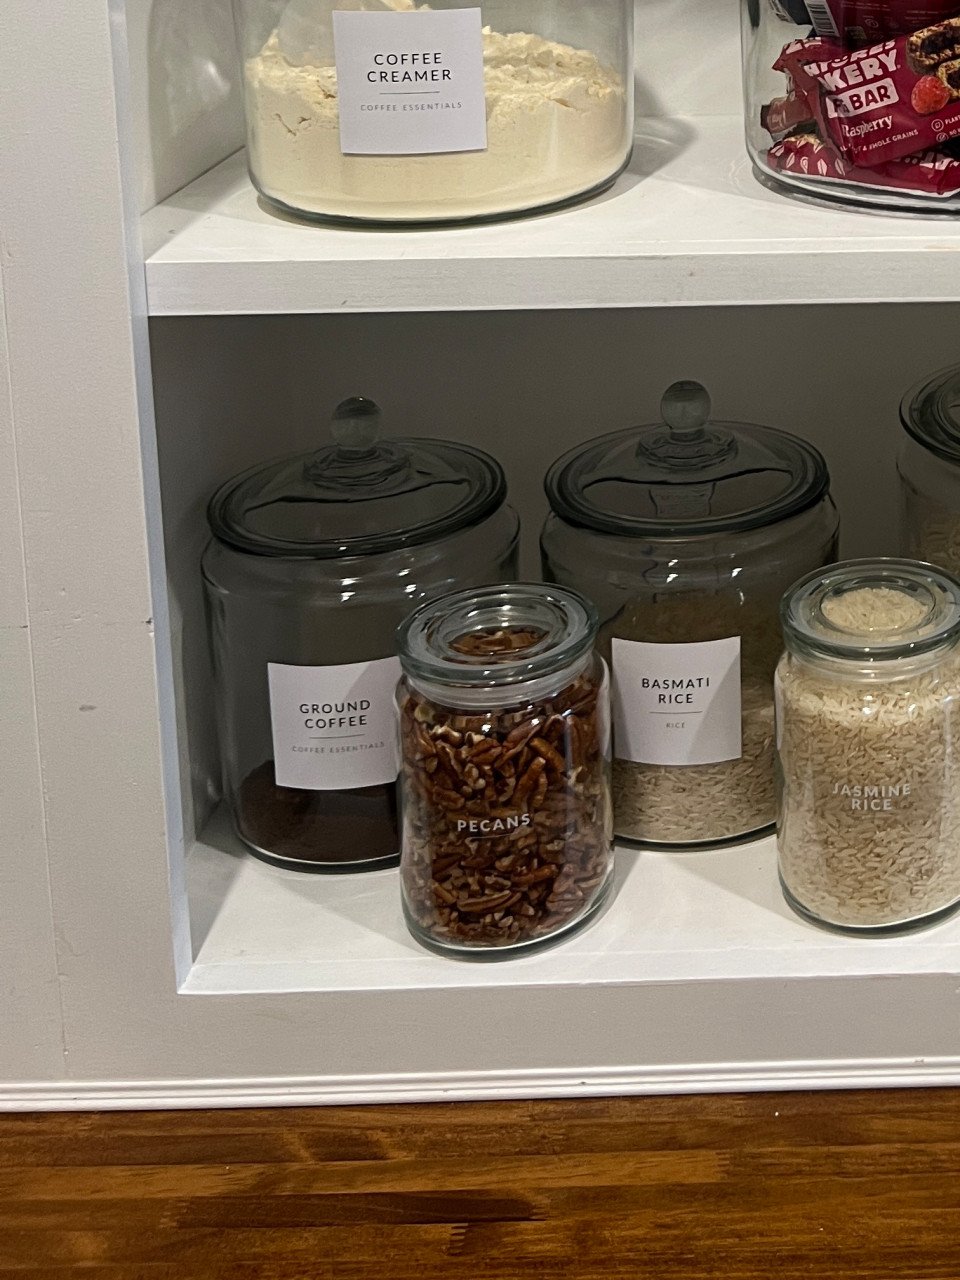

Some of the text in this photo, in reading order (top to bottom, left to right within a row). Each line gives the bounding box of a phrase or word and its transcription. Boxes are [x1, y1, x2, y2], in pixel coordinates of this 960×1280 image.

[373, 52, 443, 67] COFFEE
[366, 69, 453, 84] CREAMER
[359, 101, 463, 113] COFFEE ESSENTIALS
[841, 115, 893, 139] Raspberry
[641, 676, 711, 690] BASMATI
[658, 693, 695, 705] RICE
[299, 699, 371, 715] GROUND
[304, 714, 369, 730] COFFEE
[665, 721, 687, 729] RICE
[291, 741, 386, 754] COFFEE ESSENTIALS
[832, 782, 912, 798] JASMINE
[851, 798, 893, 811] RICE
[456, 813, 531, 833] PECANS
